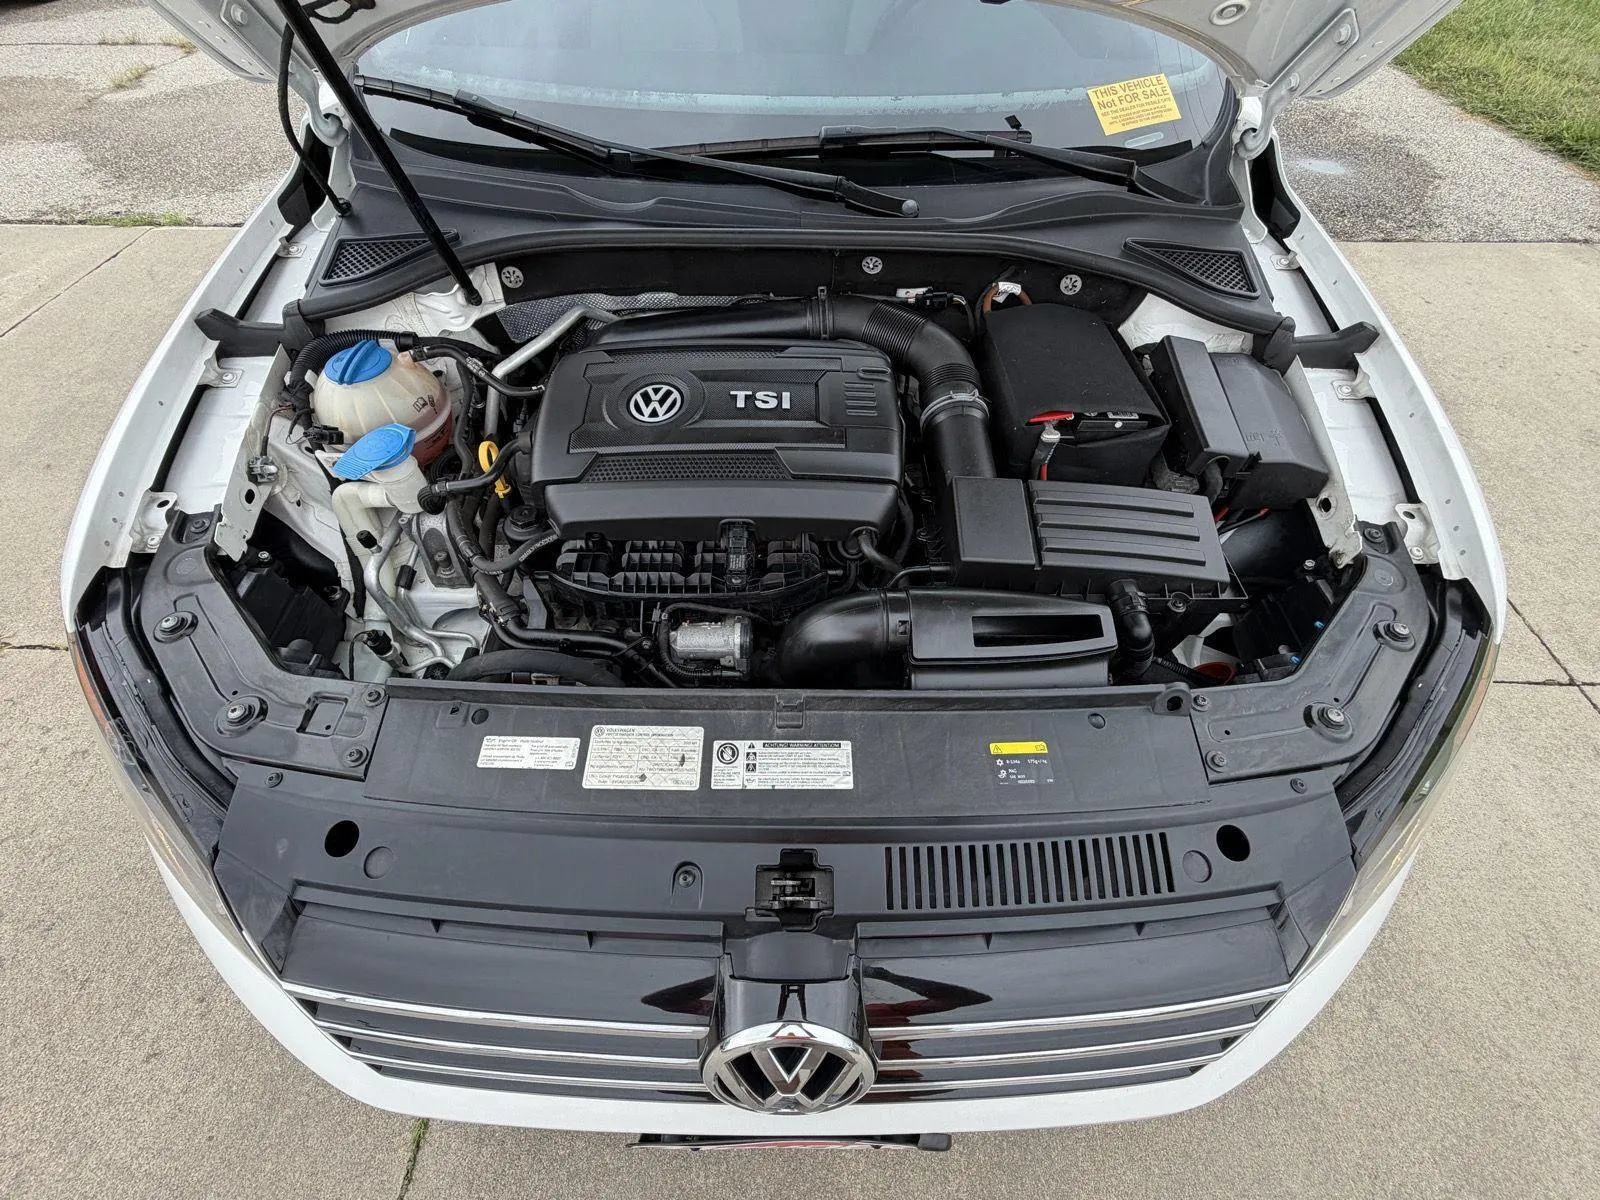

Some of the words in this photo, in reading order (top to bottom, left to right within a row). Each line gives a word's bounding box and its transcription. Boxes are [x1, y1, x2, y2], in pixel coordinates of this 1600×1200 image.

[1092, 86, 1118, 99] THIS
[1119, 76, 1164, 93] VEHICLE
[1097, 97, 1116, 110] Not
[1118, 92, 1141, 105] FOR
[1141, 86, 1169, 99] SALE
[729, 390, 791, 410] TSI
[702, 1022, 875, 1115] VW
